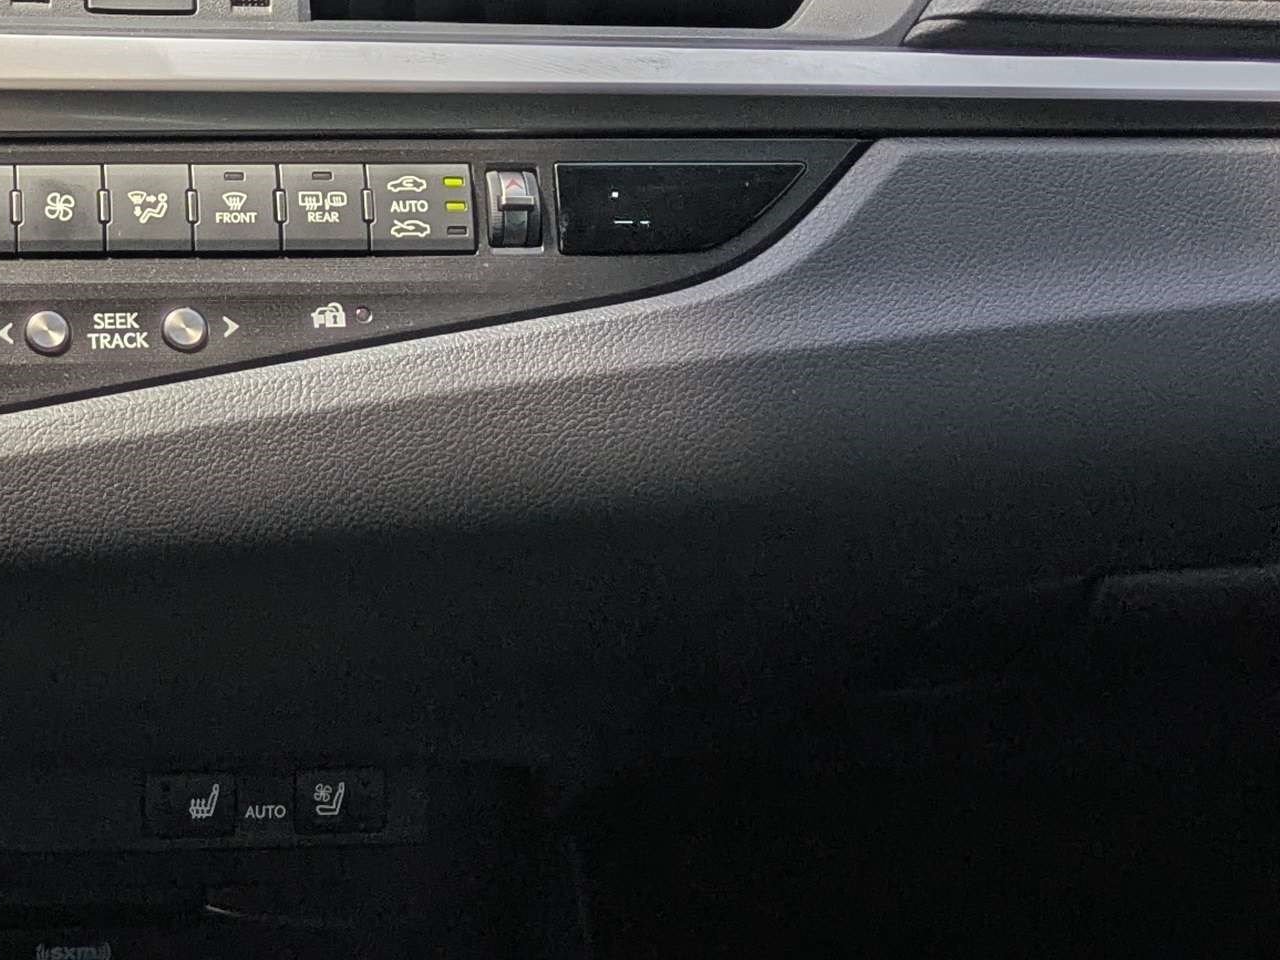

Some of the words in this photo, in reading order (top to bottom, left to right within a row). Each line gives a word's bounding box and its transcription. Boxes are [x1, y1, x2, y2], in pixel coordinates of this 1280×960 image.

[390, 200, 429, 214] AUTO
[215, 211, 258, 224] FRONT
[307, 211, 340, 224] REAR
[93, 312, 141, 330] SEEK
[87, 332, 150, 350] TRACK
[245, 805, 287, 820] AUTO
